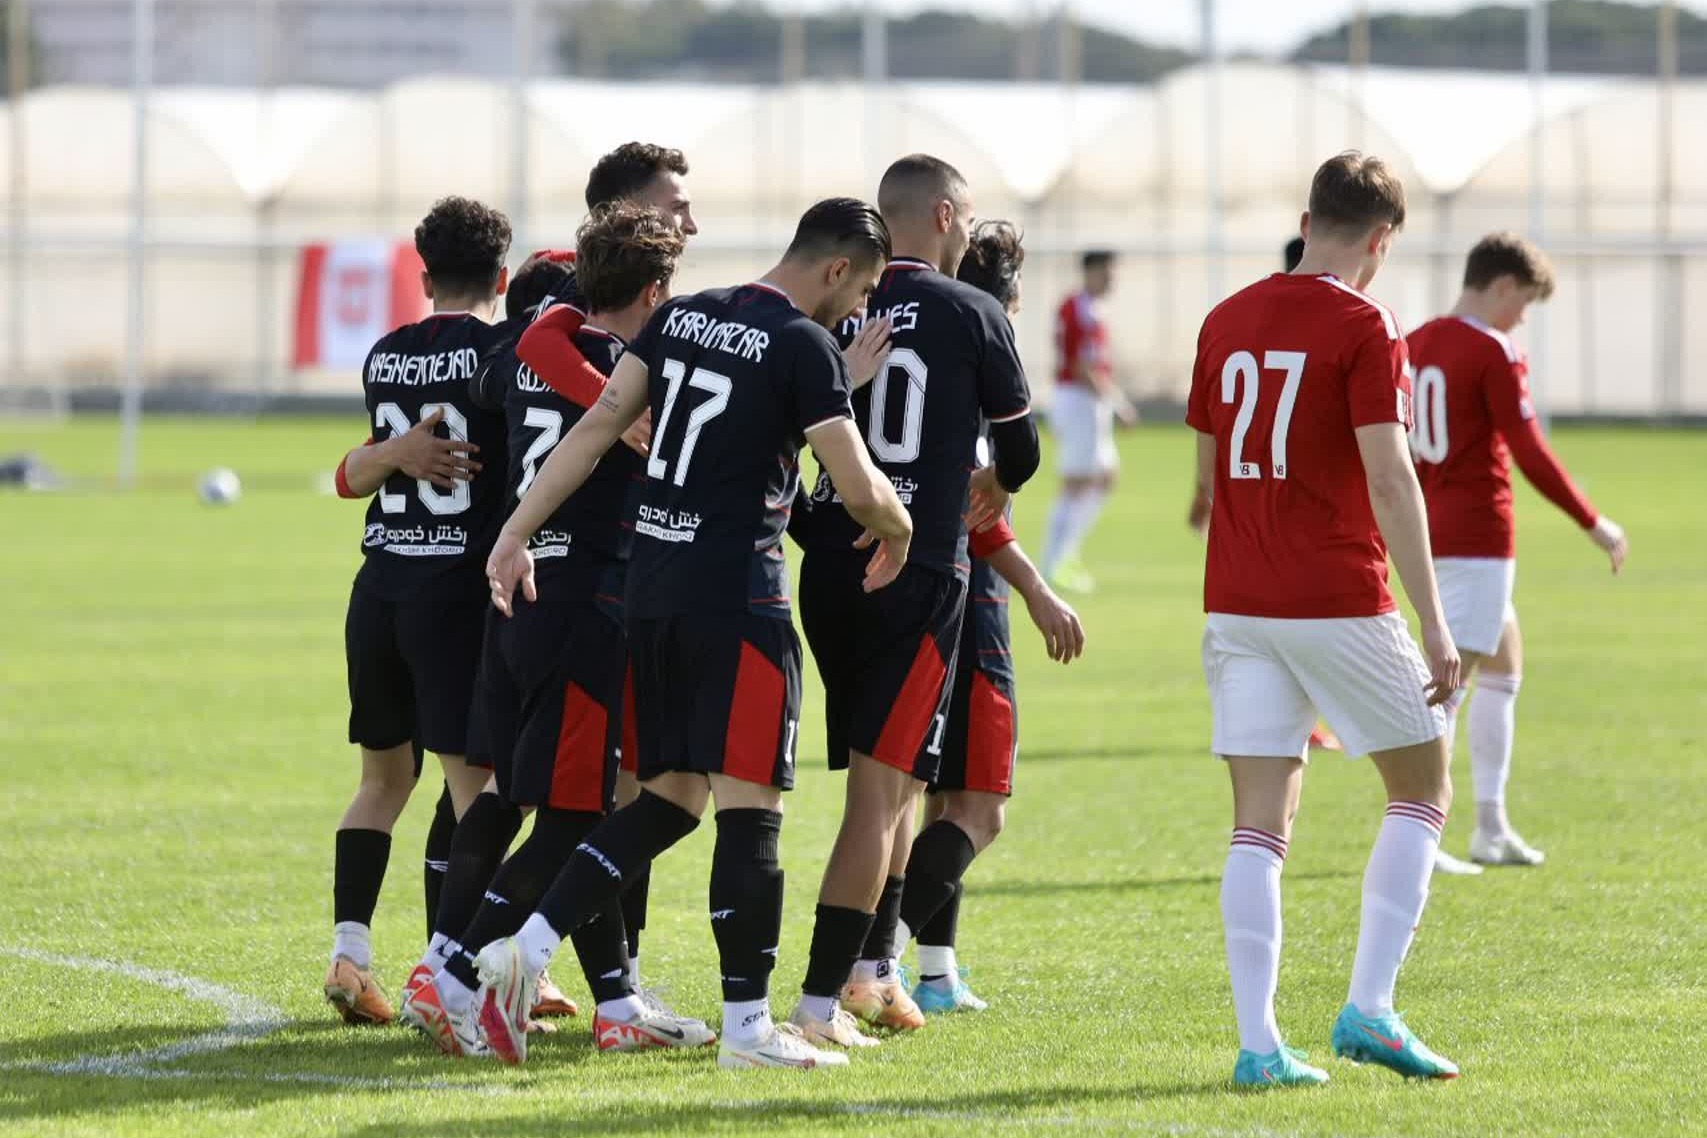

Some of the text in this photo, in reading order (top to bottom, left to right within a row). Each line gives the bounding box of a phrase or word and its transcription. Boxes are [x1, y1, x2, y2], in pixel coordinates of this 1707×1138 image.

[375, 402, 471, 516] 20
[515, 406, 563, 500] 7
[646, 357, 733, 488] 17
[867, 347, 929, 464] 0
[1220, 350, 1307, 480] 27
[1408, 364, 1449, 465] 0
[785, 719, 799, 763] 1
